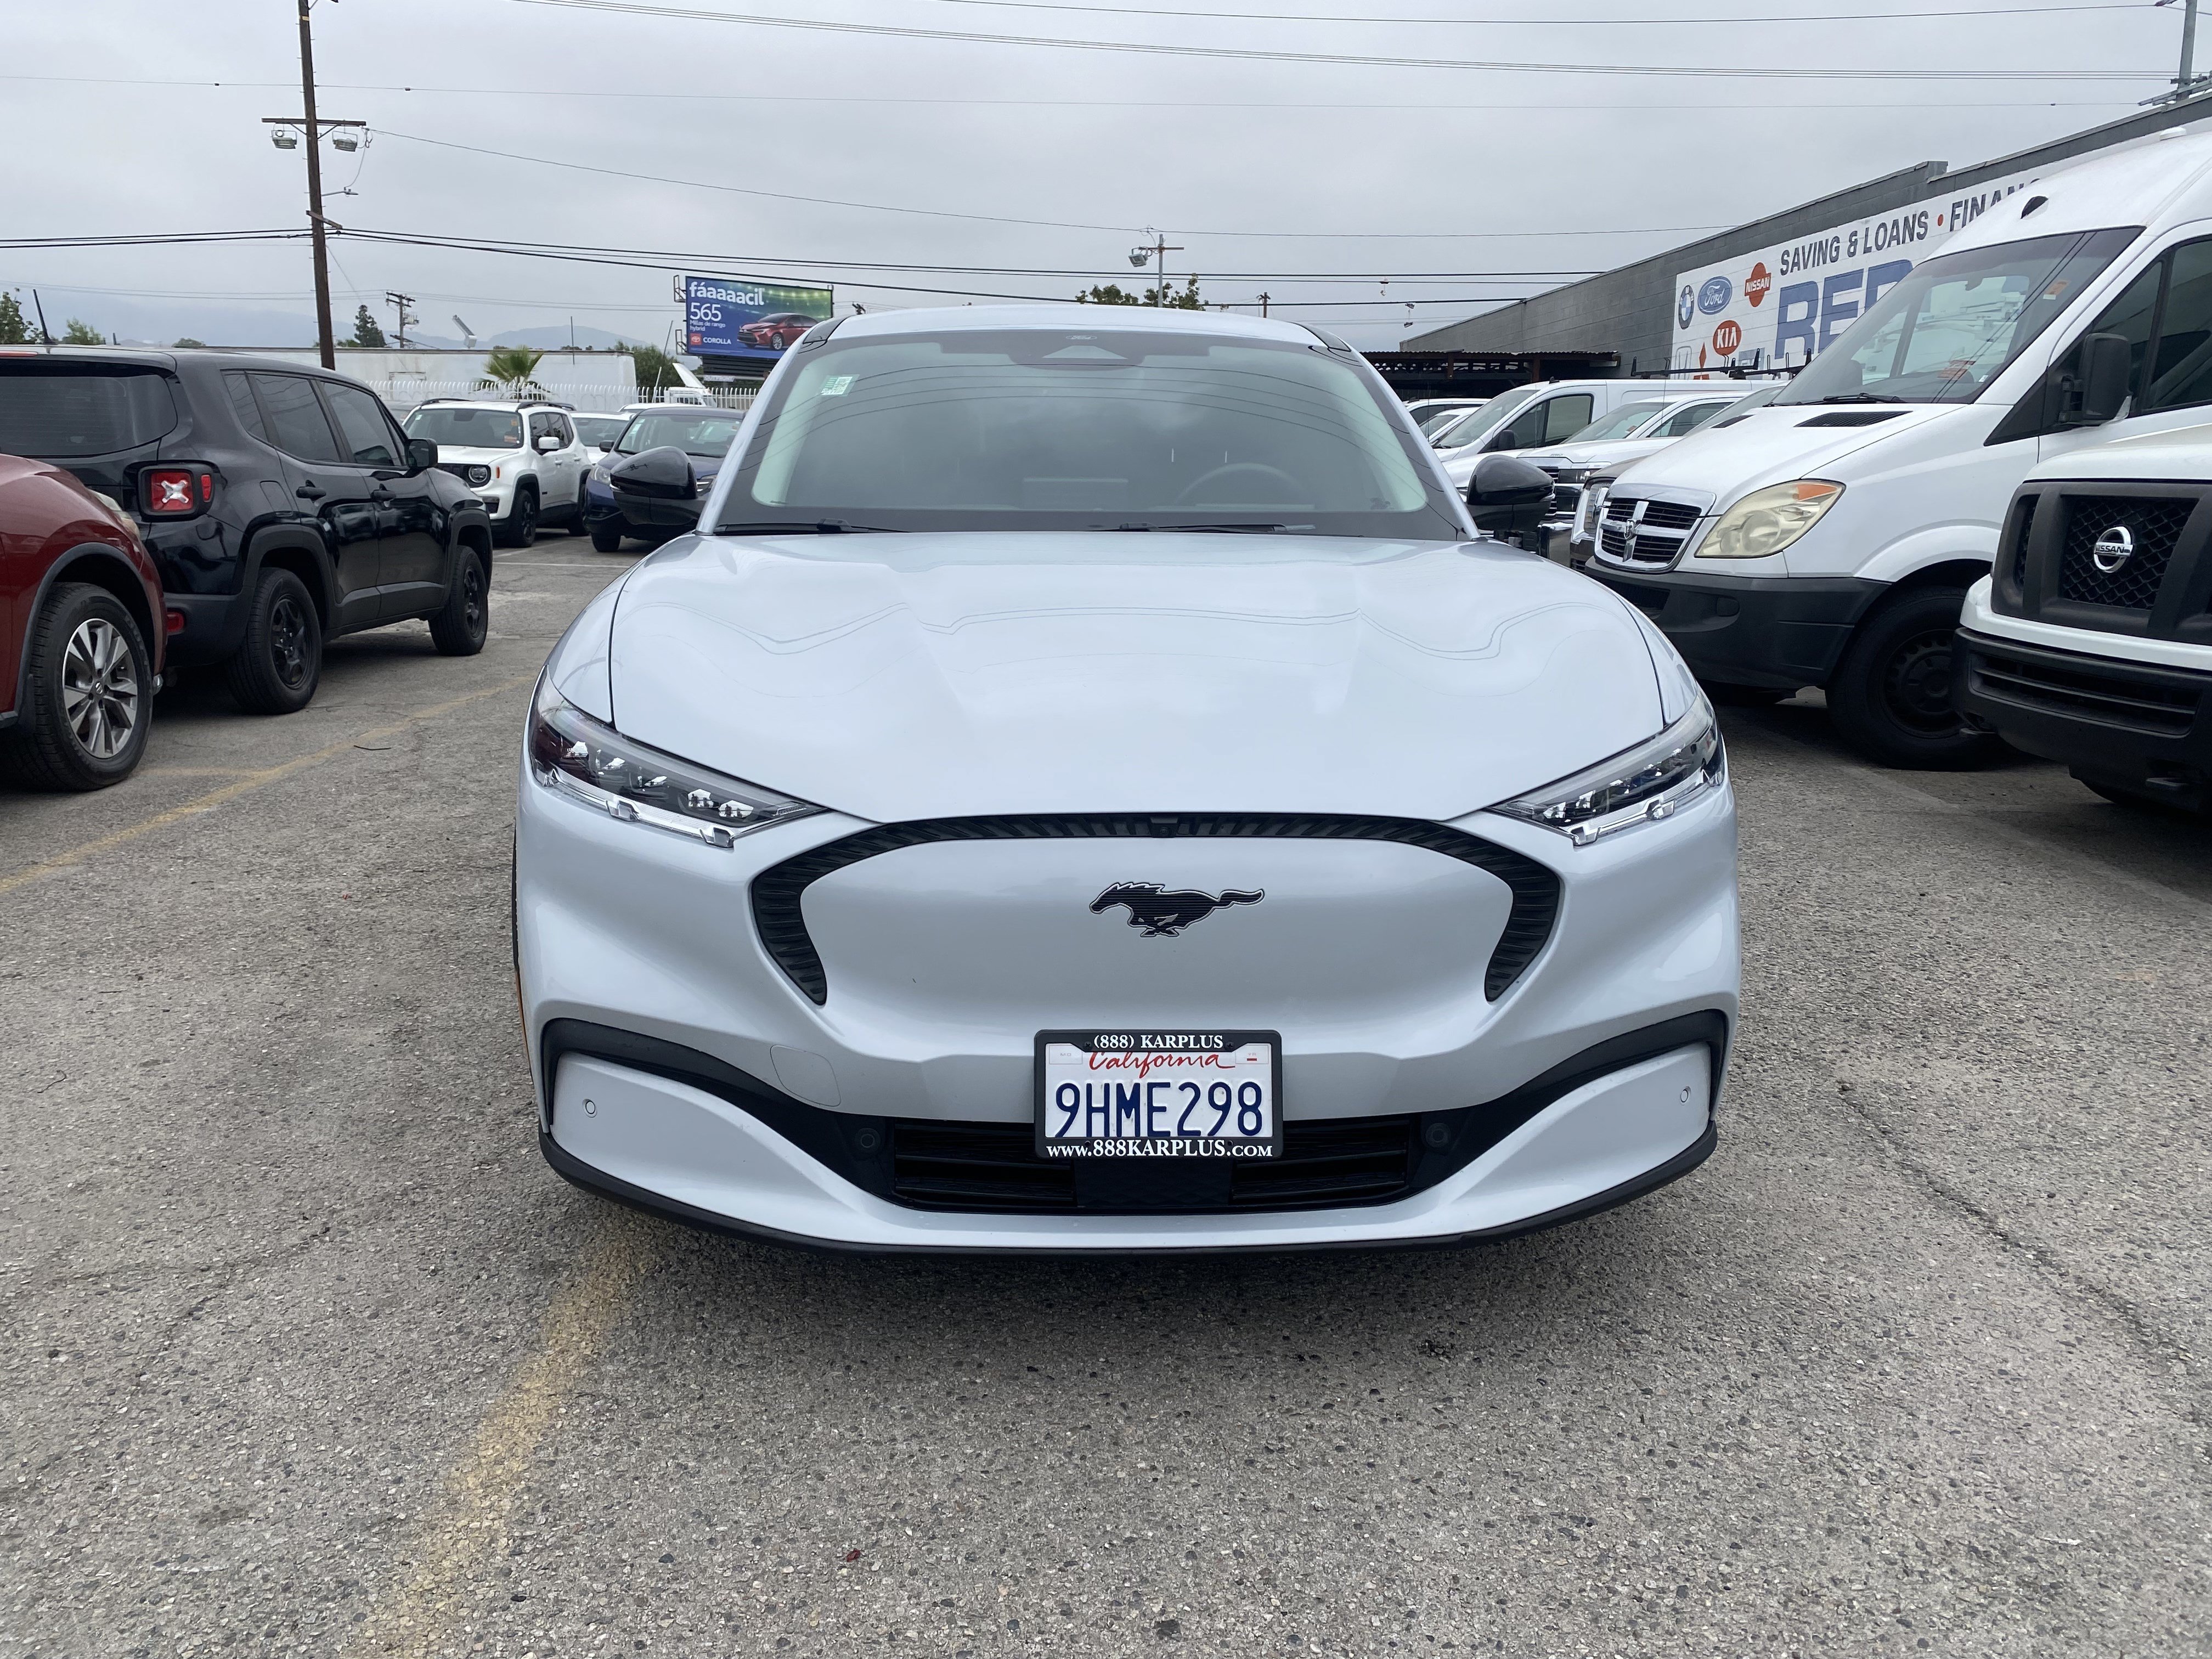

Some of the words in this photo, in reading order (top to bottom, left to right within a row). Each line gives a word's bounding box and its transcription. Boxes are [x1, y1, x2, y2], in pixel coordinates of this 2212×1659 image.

[1780, 236, 1840, 275] SAVING
[1847, 230, 1858, 257] &
[1863, 211, 1929, 255] LOANS
[689, 281, 765, 306] fáaaaacil
[1705, 285, 1725, 306] Ford
[1746, 276, 1770, 293] NISSAN
[690, 302, 721, 321] 565
[1717, 326, 1737, 349] KIA
[1094, 1035, 1135, 1049] (888)
[1140, 1035, 1223, 1048] KARPLUS
[1089, 1051, 1235, 1079] California
[1055, 1081, 1262, 1137] 9HME298
